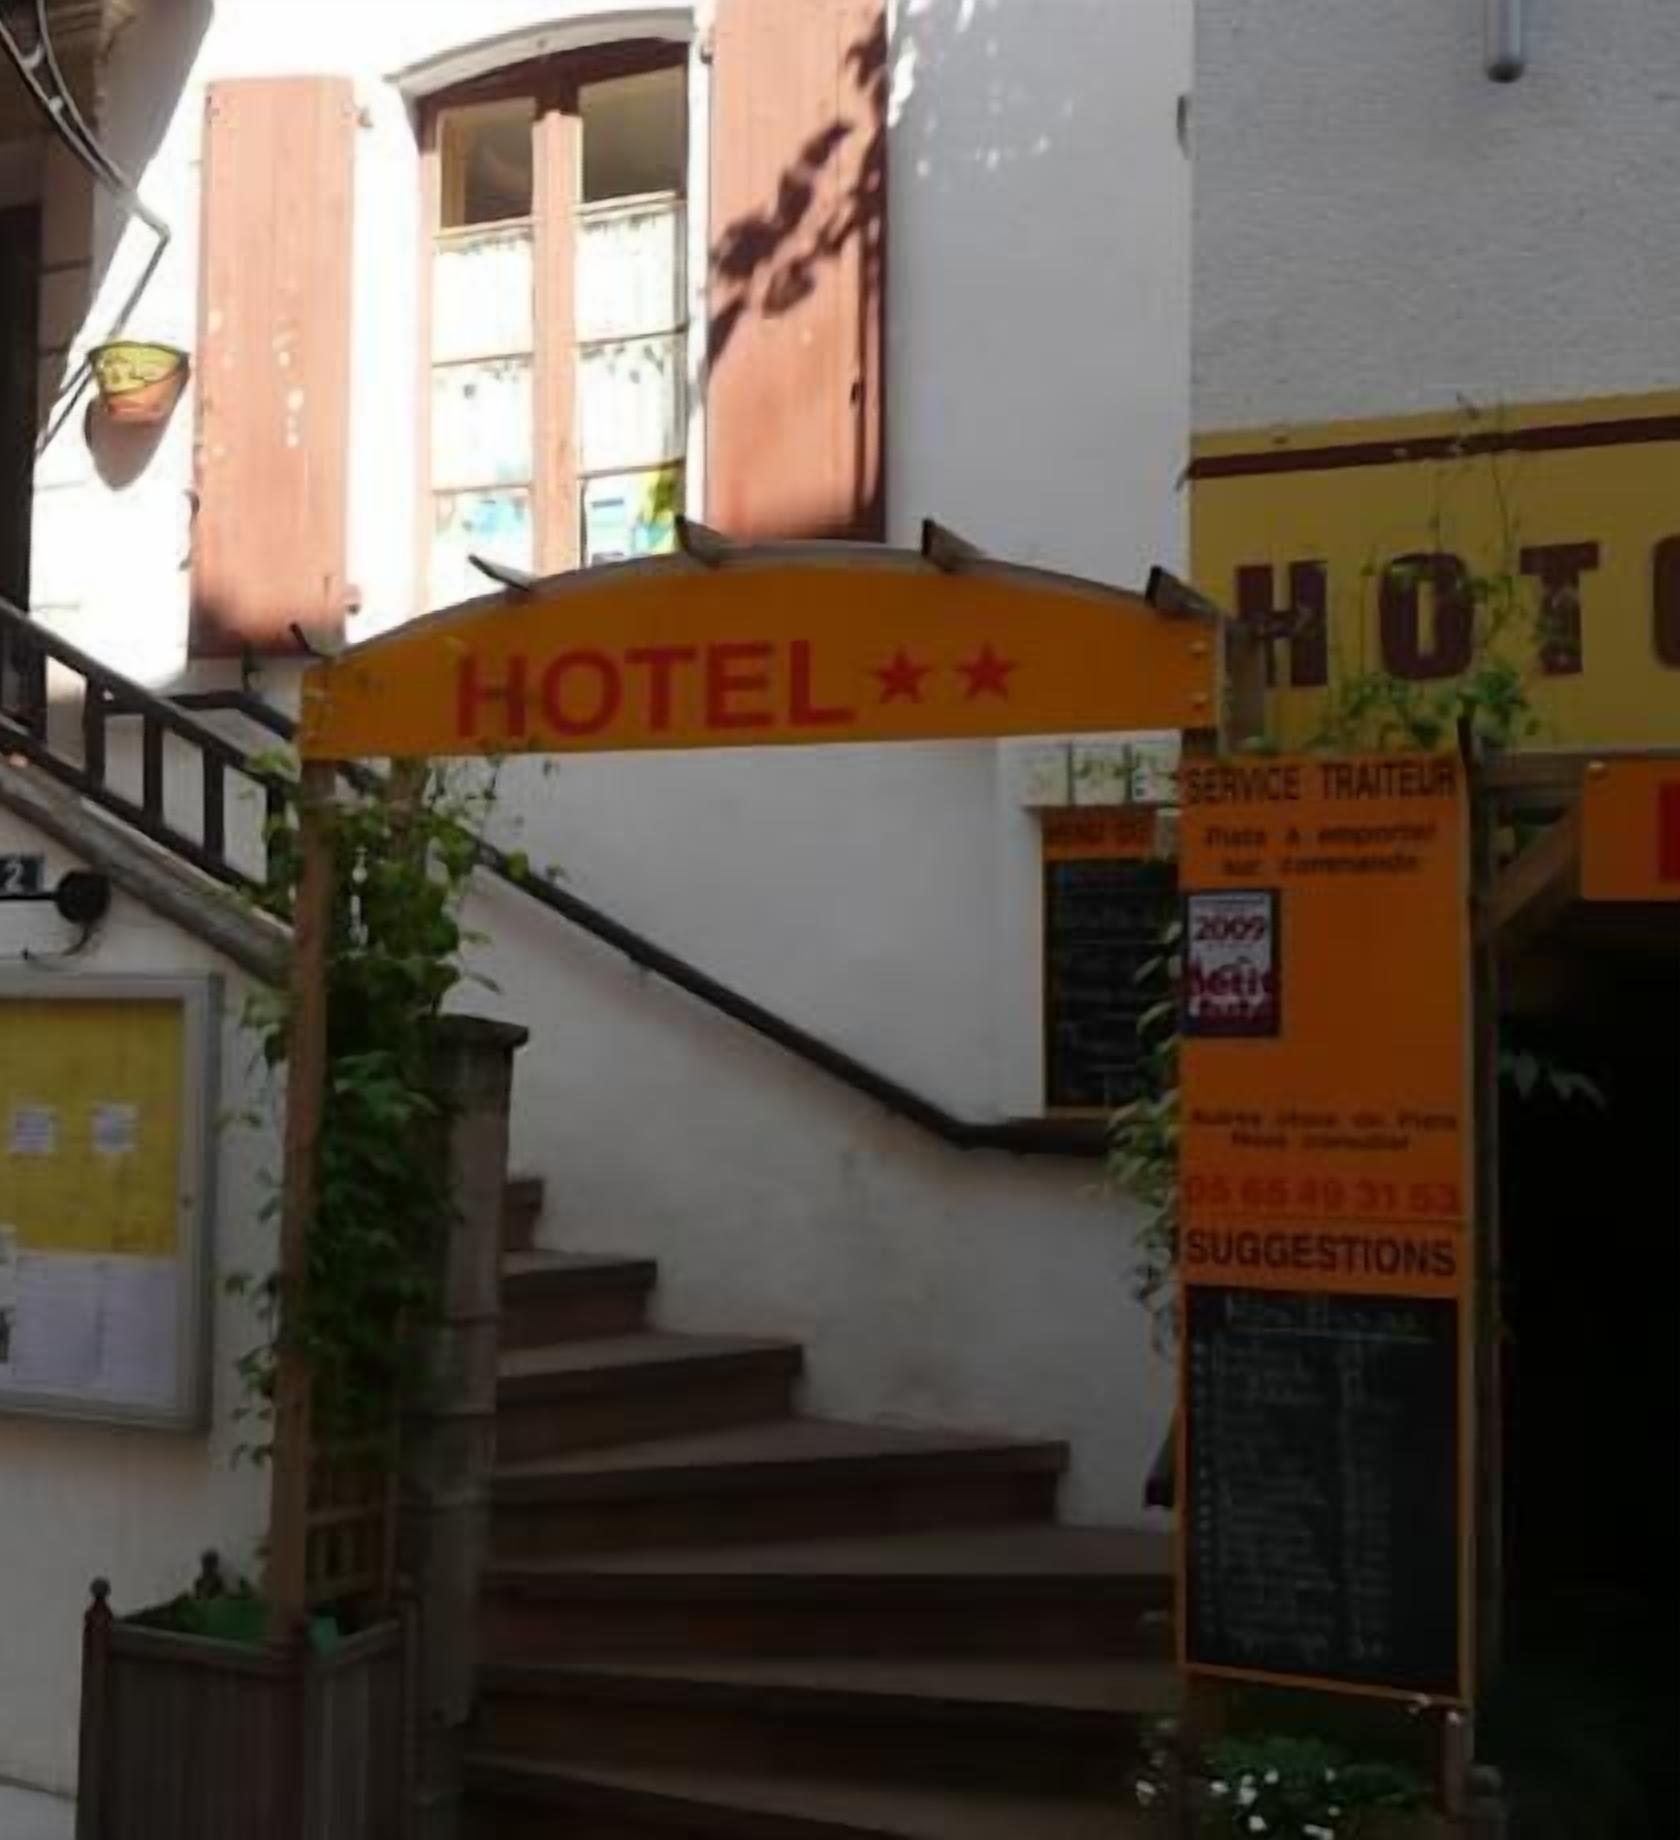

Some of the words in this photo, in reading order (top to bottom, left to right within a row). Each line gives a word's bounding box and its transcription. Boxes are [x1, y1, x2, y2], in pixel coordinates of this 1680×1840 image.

[454, 638, 854, 739] HOTEL
[1186, 766, 1300, 804] SERVICE
[1322, 756, 1457, 800] TRAITEUR
[4, 858, 25, 894] 2
[1195, 913, 1266, 942] 2009
[1184, 1228, 1457, 1278] SUGGESTIONS
